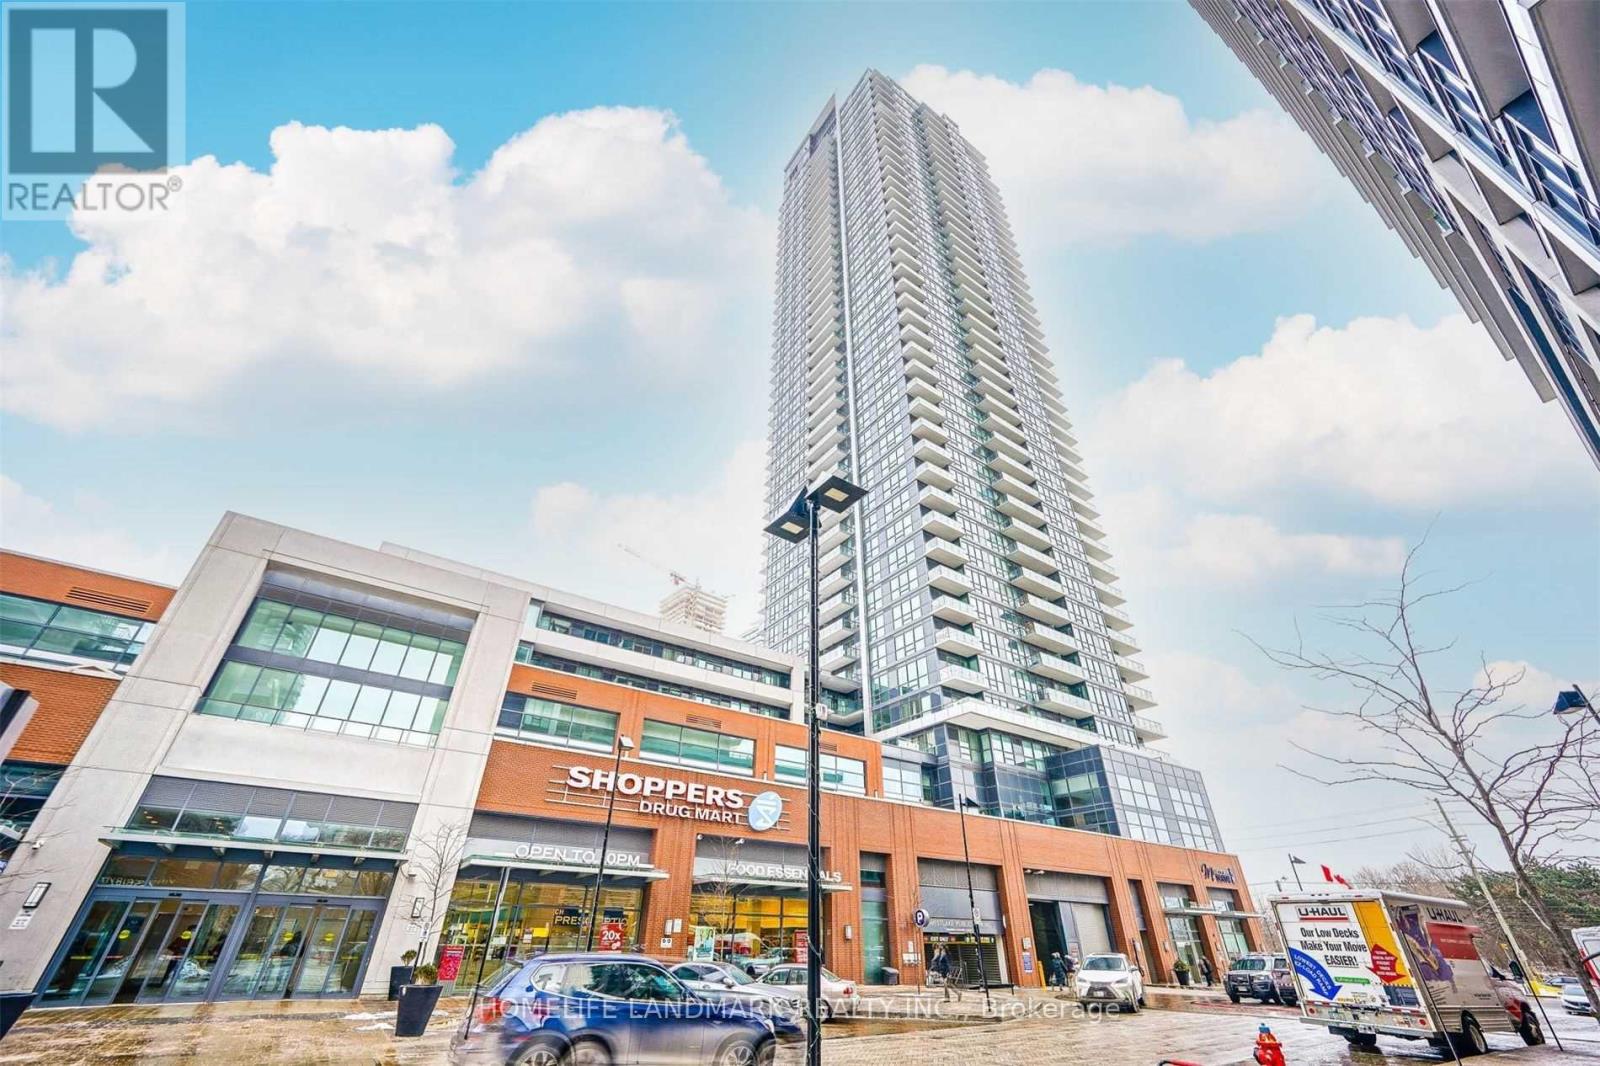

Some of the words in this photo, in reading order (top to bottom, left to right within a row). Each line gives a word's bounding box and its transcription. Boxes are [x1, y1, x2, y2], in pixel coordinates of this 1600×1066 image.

[566, 766, 744, 809] SHOPPERS
[639, 800, 690, 817] DRUG
[695, 809, 741, 824] MART
[515, 845, 567, 861] OPEN
[571, 849, 595, 865] TO
[600, 852, 641, 866] 0PM
[727, 863, 765, 876] FOOD
[767, 866, 842, 882] ESSENALS
[1298, 907, 1347, 917] U-HAUL
[1427, 907, 1463, 923] U-HAUL
[602, 930, 621, 941] 20x
[1300, 927, 1315, 938] Our
[1315, 928, 1332, 938] Low
[1332, 928, 1360, 939] Decks
[1300, 940, 1324, 951] Make
[1323, 941, 1343, 952] Your
[1343, 941, 1368, 952] Move
[1324, 954, 1359, 967] EASIER!
